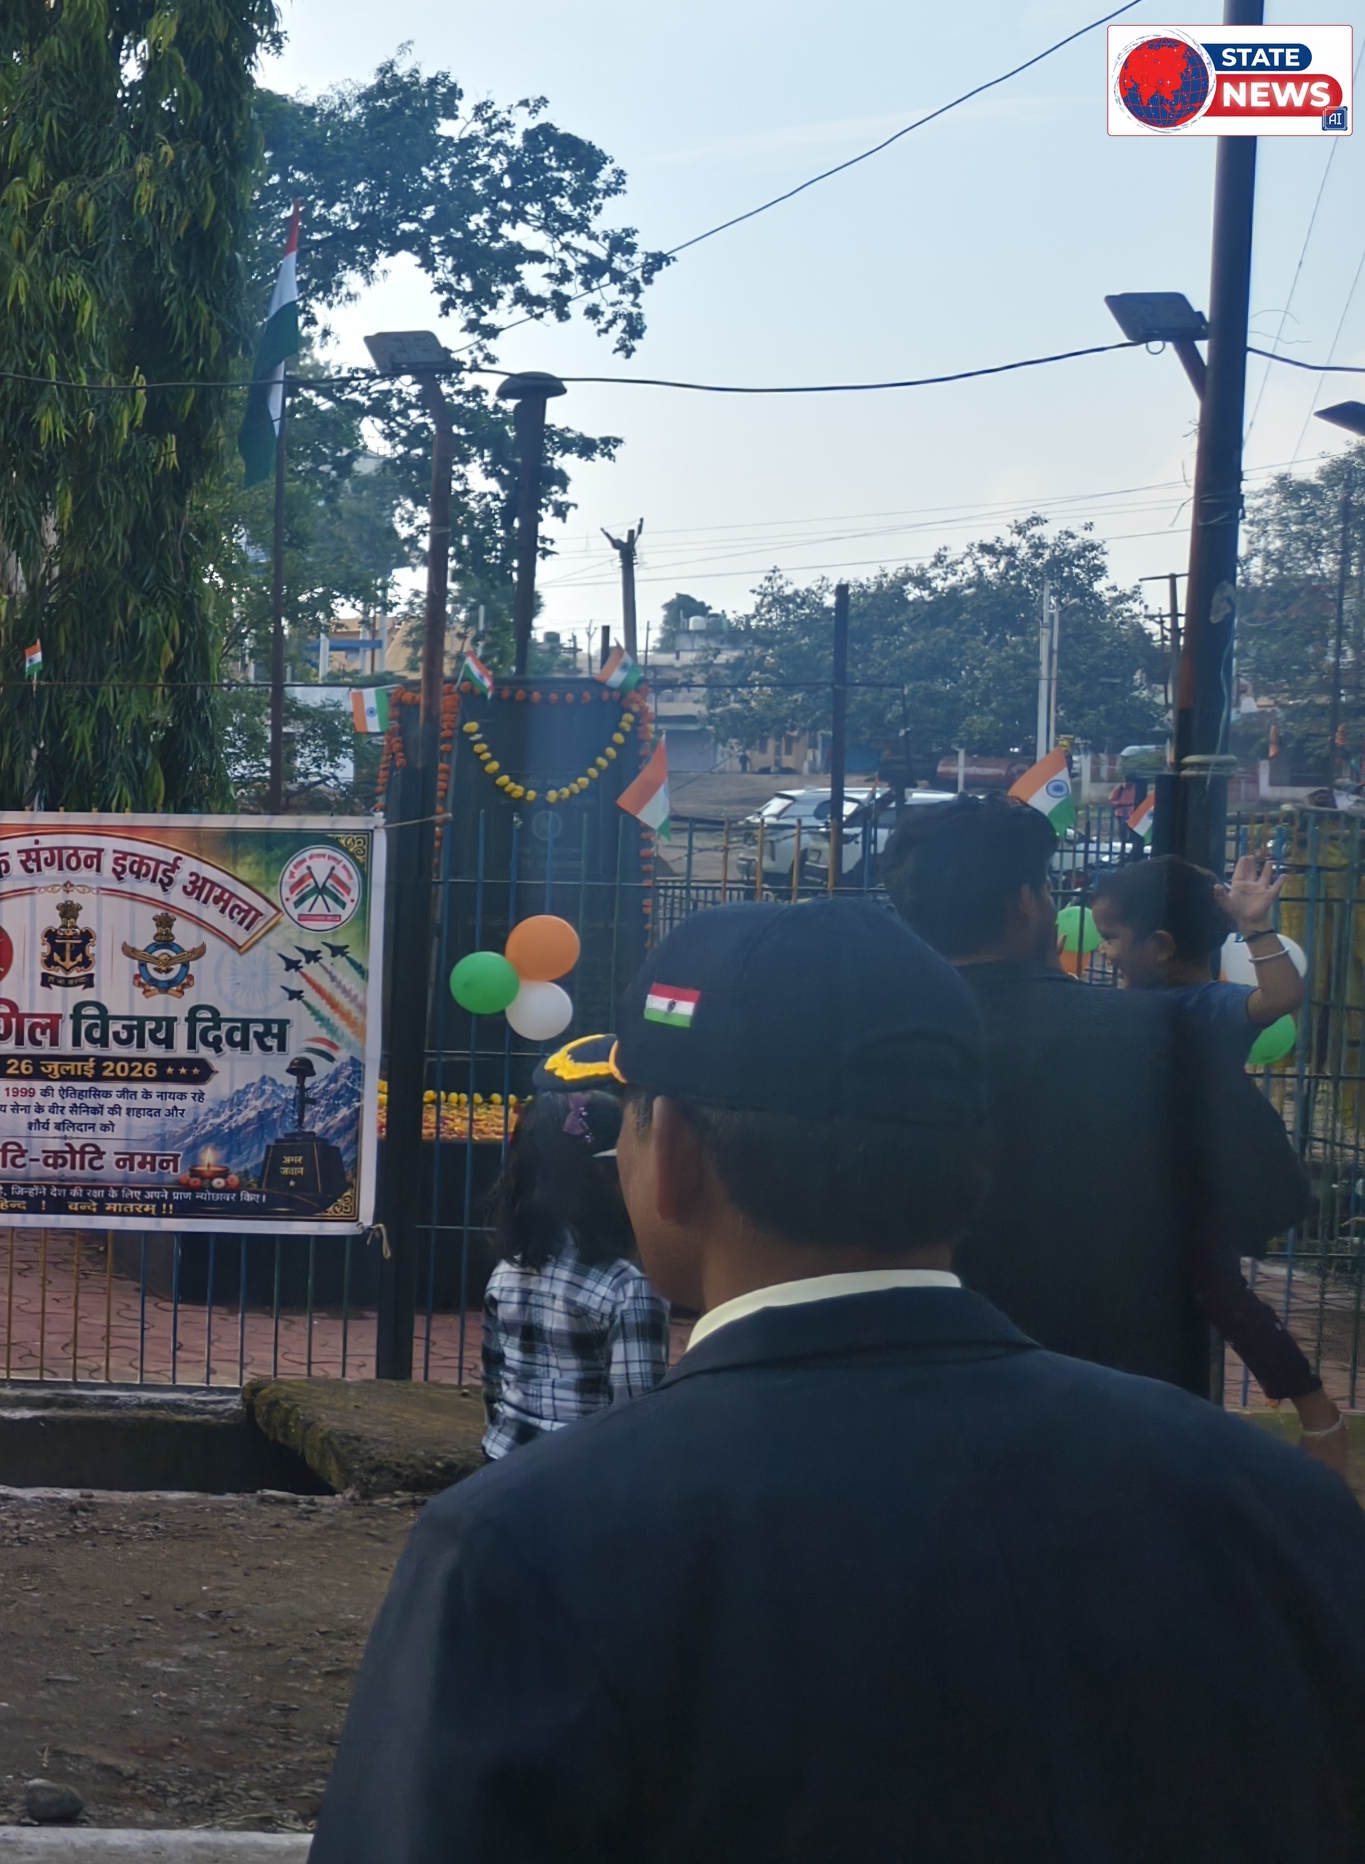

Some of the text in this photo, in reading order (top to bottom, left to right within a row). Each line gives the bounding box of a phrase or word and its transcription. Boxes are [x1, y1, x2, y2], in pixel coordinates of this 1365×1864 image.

[17, 839, 105, 873] संगठन
[112, 850, 183, 892] इकाई
[182, 872, 264, 932] आमला
[70, 1000, 177, 1050] विजय
[185, 1004, 290, 1054] दिवस
[6, 1058, 158, 1079] 26 जुलाई 2026
[5, 1087, 36, 1097] 1999
[40, 1084, 54, 1097] की
[58, 1086, 113, 1100] ऐतिहासिक
[116, 1087, 138, 1100] जीत
[141, 1088, 153, 1100] के
[156, 1091, 187, 1102] नायक
[191, 1089, 205, 1103] रहे
[10, 1101, 30, 1114] सेना
[34, 1102, 44, 1114] के
[48, 1102, 66, 1115] वीर
[69, 1103, 104, 1116] सैनिकों
[107, 1104, 122, 1116] की
[126, 1107, 161, 1118] शहादत
[164, 1105, 185, 1118] और
[27, 1118, 115, 1132] शौर्य बलिदान को
[114, 1151, 181, 1173] नमन
[282, 1155, 303, 1164] अमर
[50, 1186, 66, 1197] देश
[70, 1187, 83, 1198] की
[86, 1188, 104, 1199] रक्षा
[108, 1186, 118, 1198] के
[122, 1188, 141, 1200] लिए
[144, 1188, 168, 1200] अपने
[172, 1190, 191, 1201] प्राण
[68, 1199, 98, 1213] वन्दे
[105, 1203, 156, 1215] मातरम्
